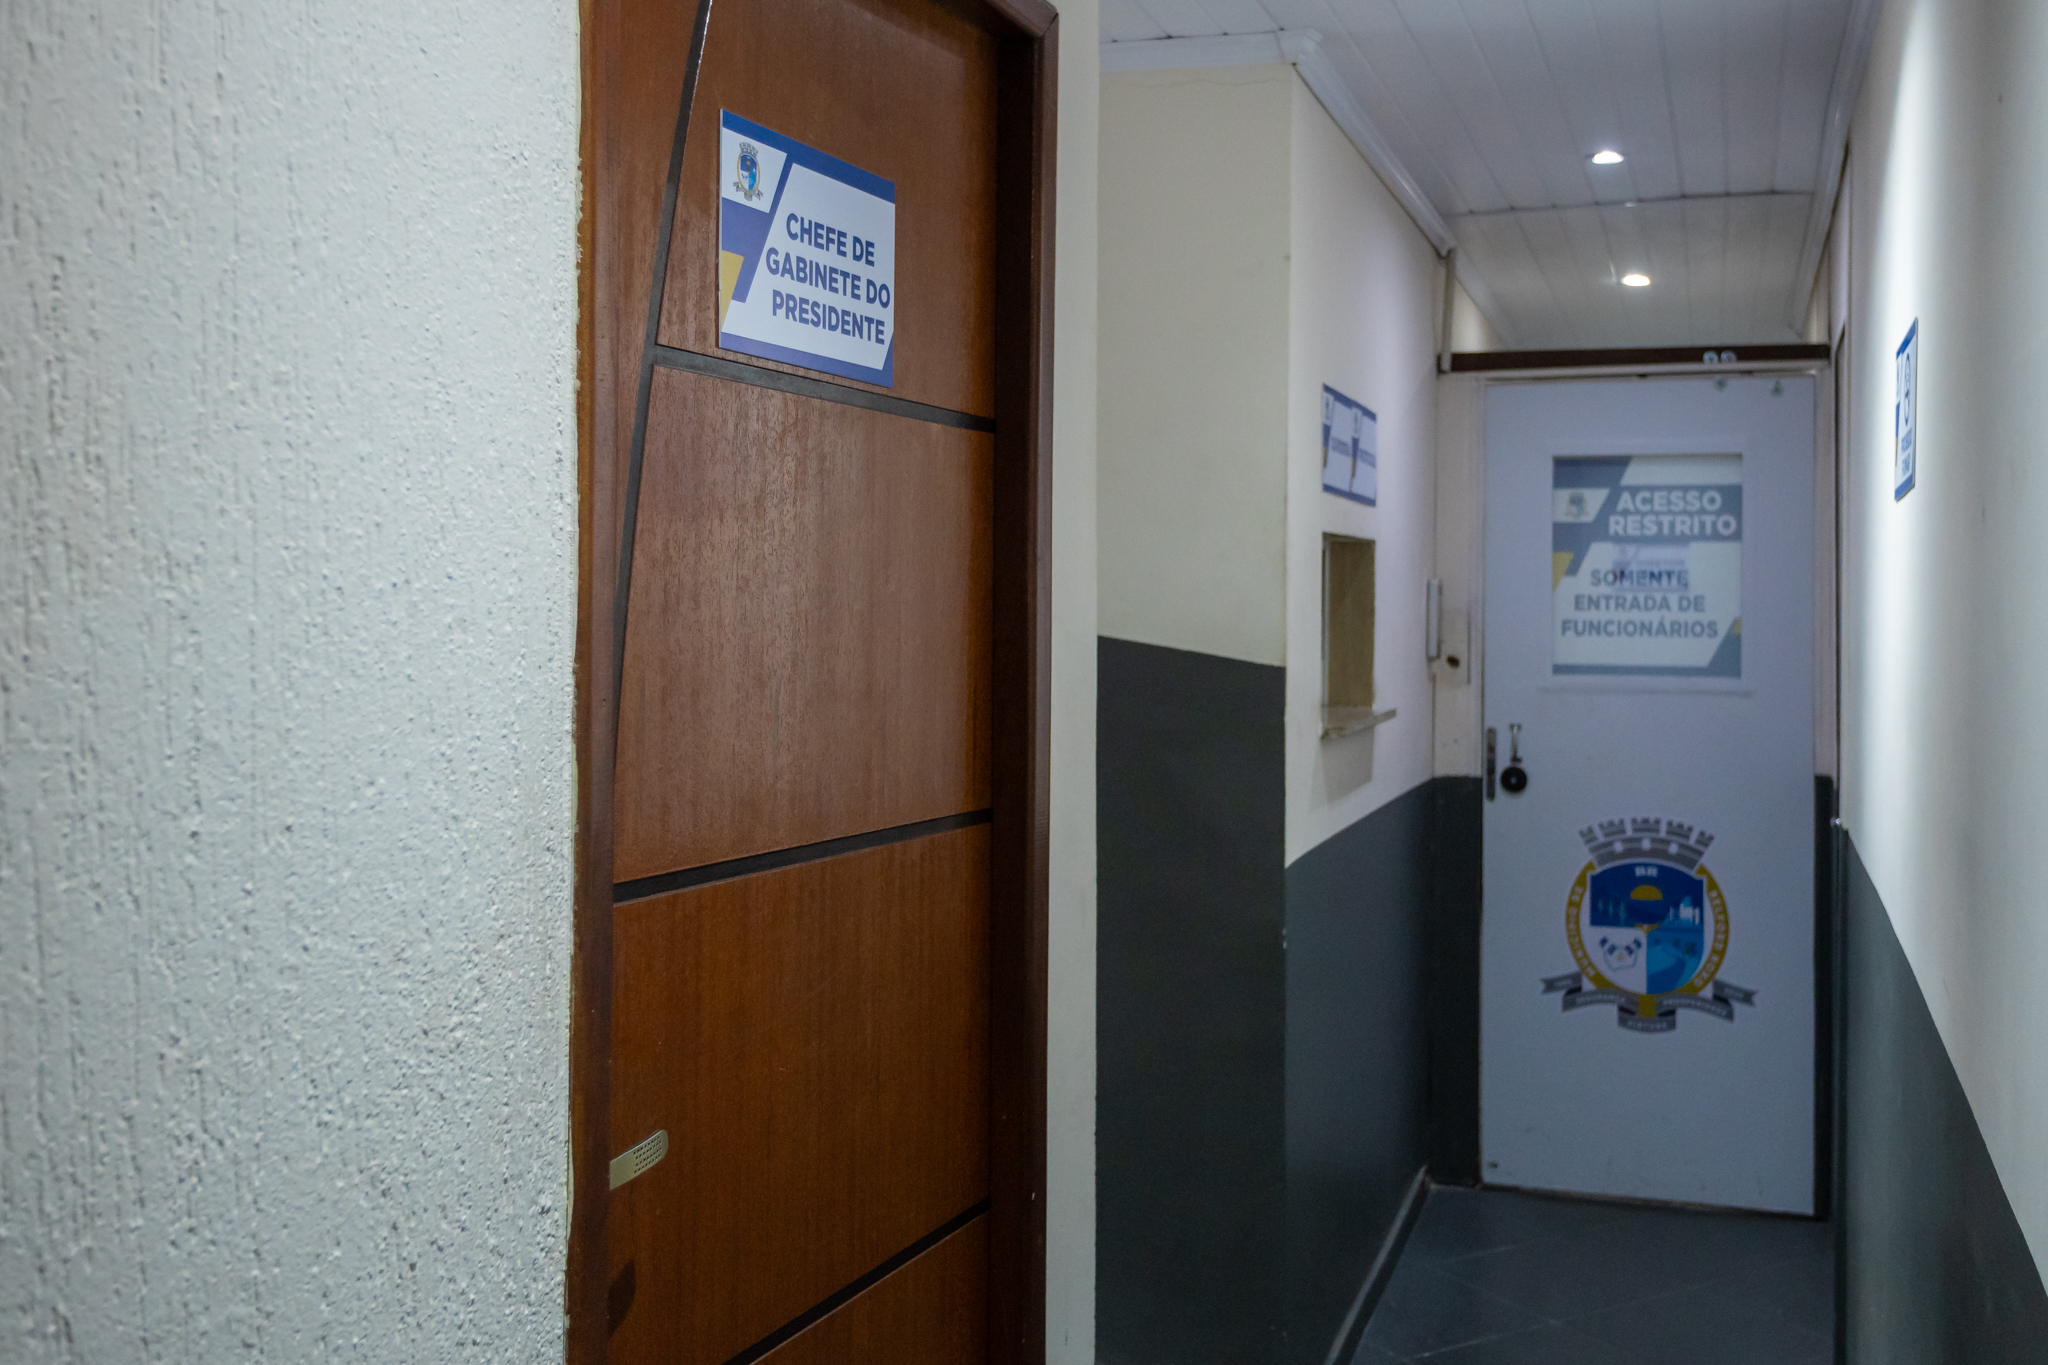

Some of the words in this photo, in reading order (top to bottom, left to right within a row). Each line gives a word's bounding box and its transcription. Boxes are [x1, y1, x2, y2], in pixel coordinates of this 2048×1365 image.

[786, 212, 847, 258] CHEFE
[852, 235, 875, 267] DE
[766, 247, 861, 301] GABINETE
[866, 277, 891, 309] DO
[772, 289, 885, 345] PRESIDENTE
[1616, 489, 1722, 512] ACESSO
[1608, 513, 1737, 536] RESTRITO
[1590, 568, 1688, 588] SOMENTE
[1574, 594, 1671, 612] ENTRADA
[1678, 594, 1705, 612] DE
[1561, 616, 1718, 638] FUNCIONÁRIOS
